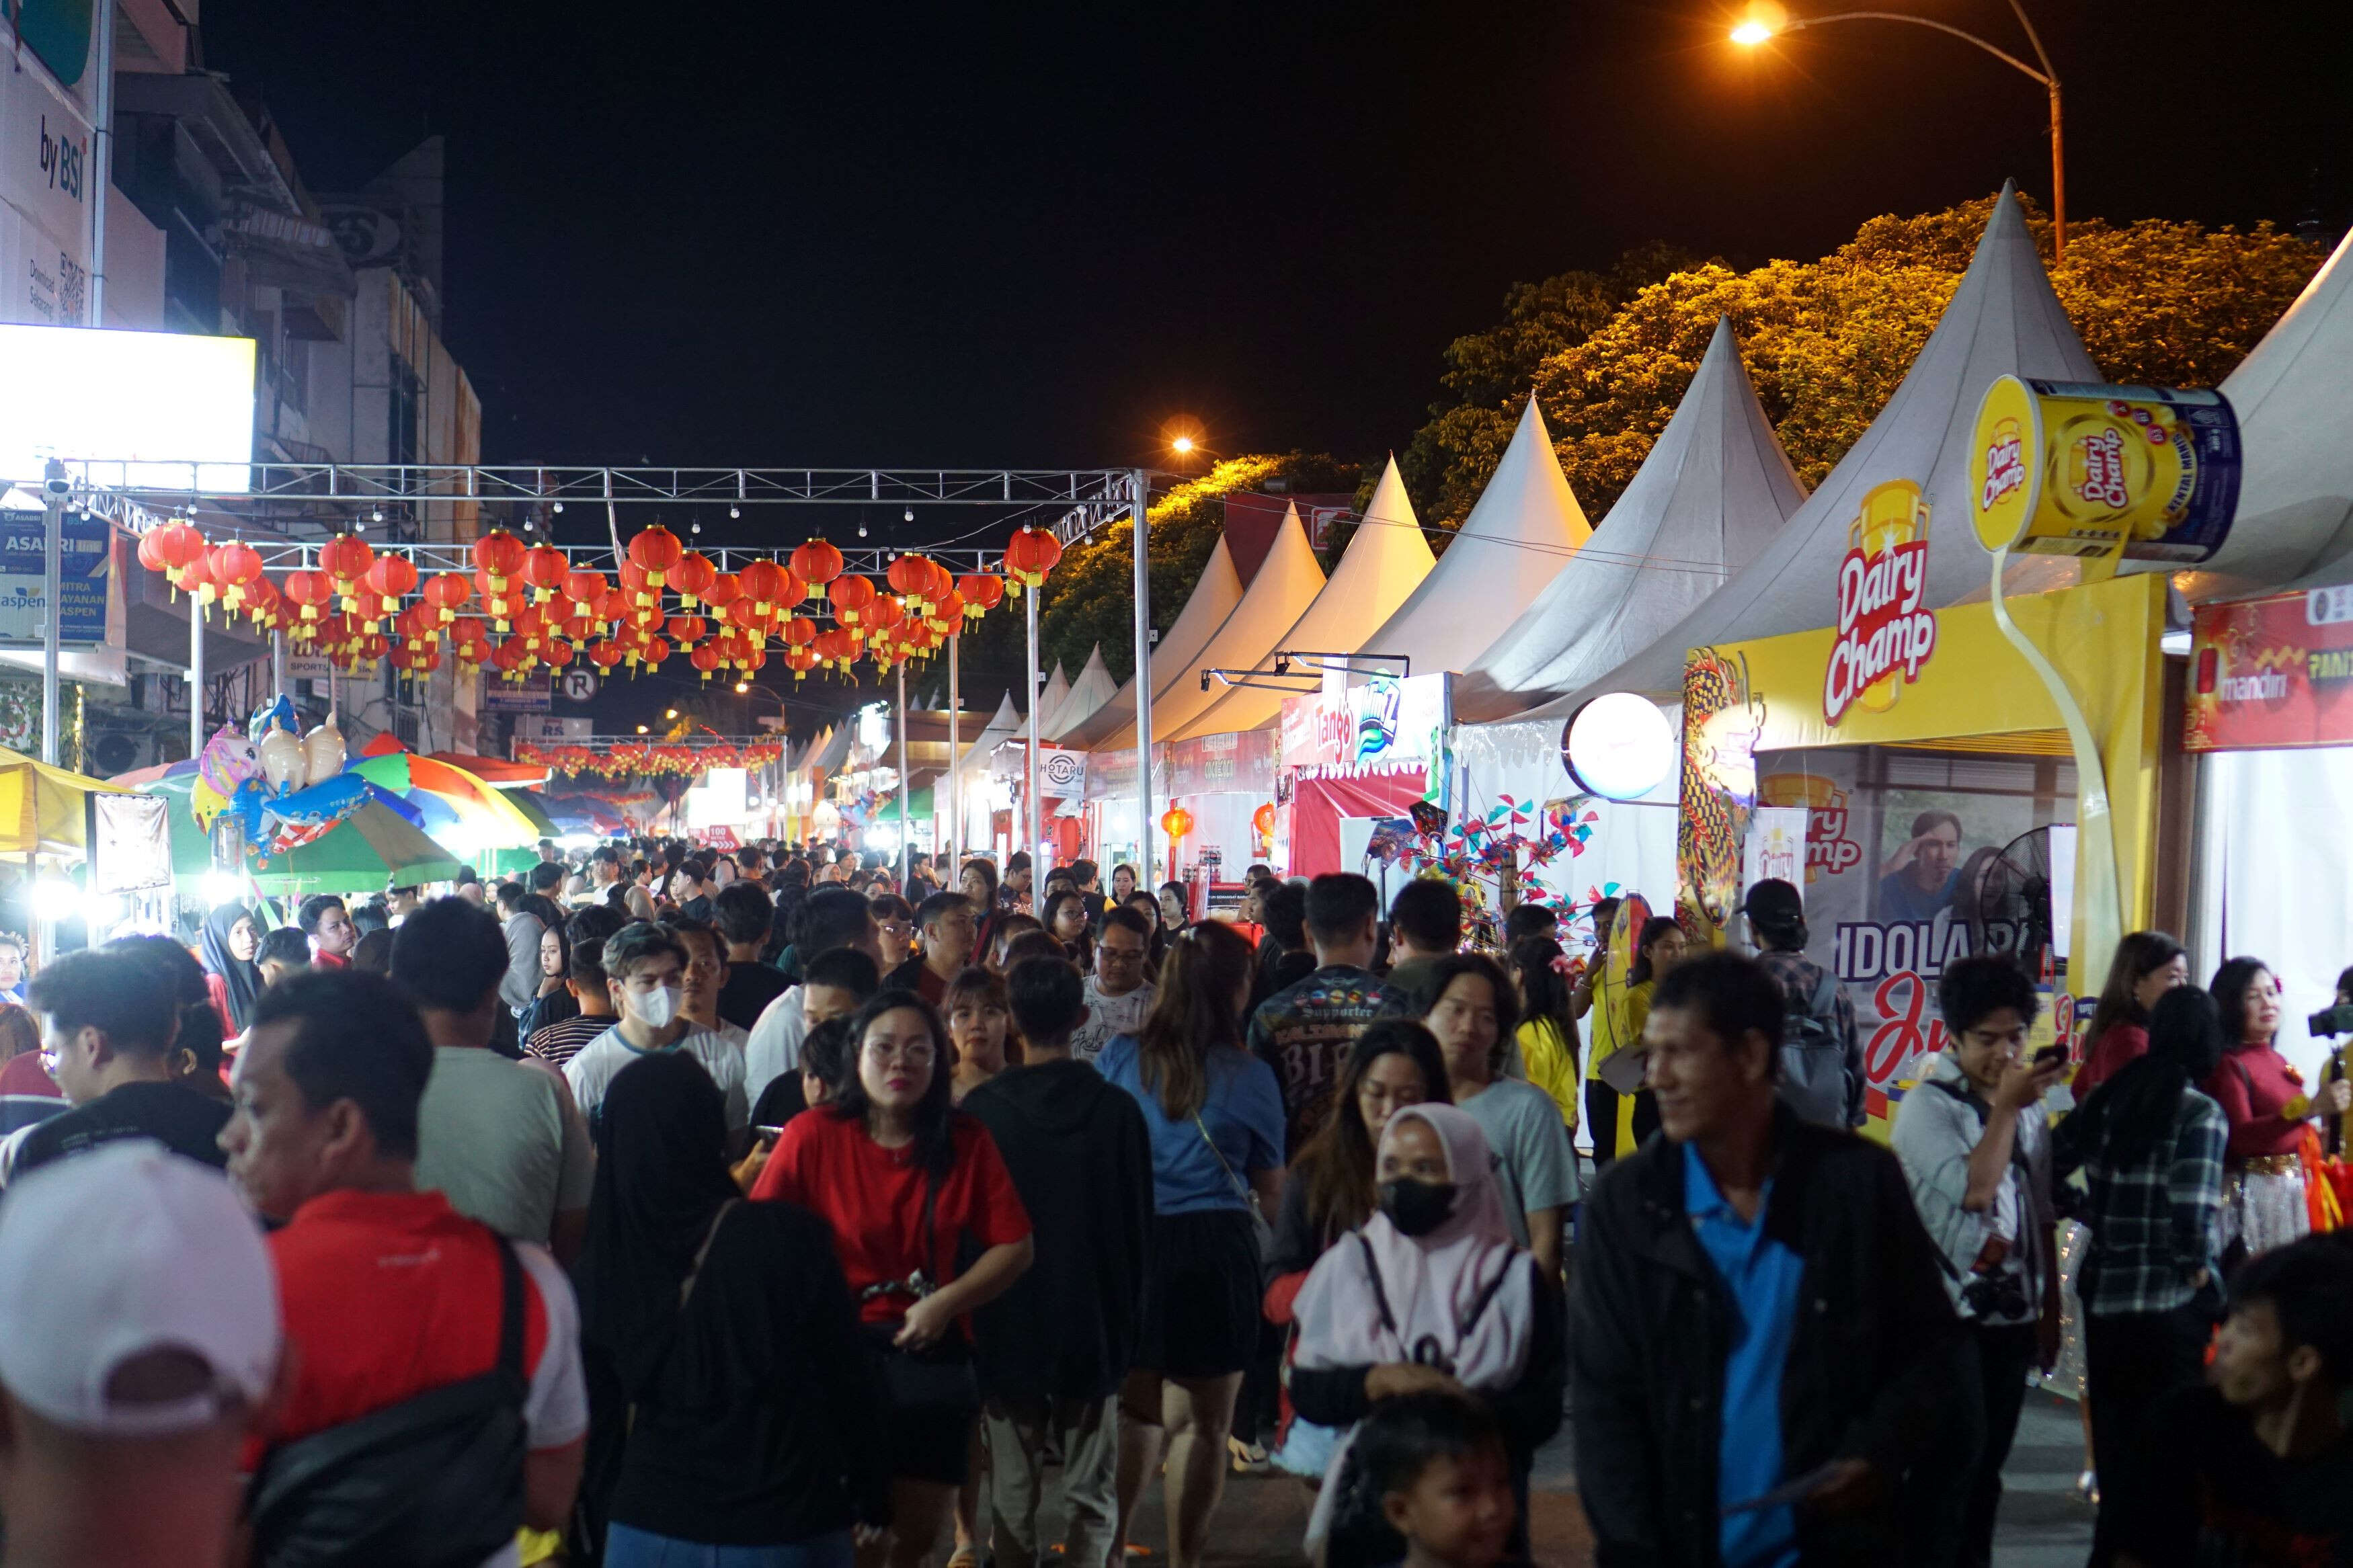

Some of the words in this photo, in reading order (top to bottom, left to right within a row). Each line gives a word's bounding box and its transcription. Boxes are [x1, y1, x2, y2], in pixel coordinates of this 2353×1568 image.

[41, 114, 57, 189] by
[61, 134, 83, 202] BSI
[1988, 442, 2020, 477] Dairy
[2085, 438, 2106, 499] Dairy
[2104, 428, 2128, 507] Champ
[1983, 464, 2024, 509] Champ
[5, 536, 74, 552] ASARI
[1, 596, 46, 611] aspen
[60, 607, 97, 616] ASPEN
[61, 594, 105, 604] AYANAN
[1841, 549, 1925, 635] Dairy
[1826, 612, 1933, 717] Champ
[2220, 667, 2287, 702] mandiri
[542, 725, 565, 736] RS
[1316, 706, 1353, 765] Tango
[1040, 764, 1084, 776] HOTARU
[711, 827, 726, 836] 100
[1839, 923, 1971, 979] IDOLA
[1866, 970, 1951, 1083] Ju
